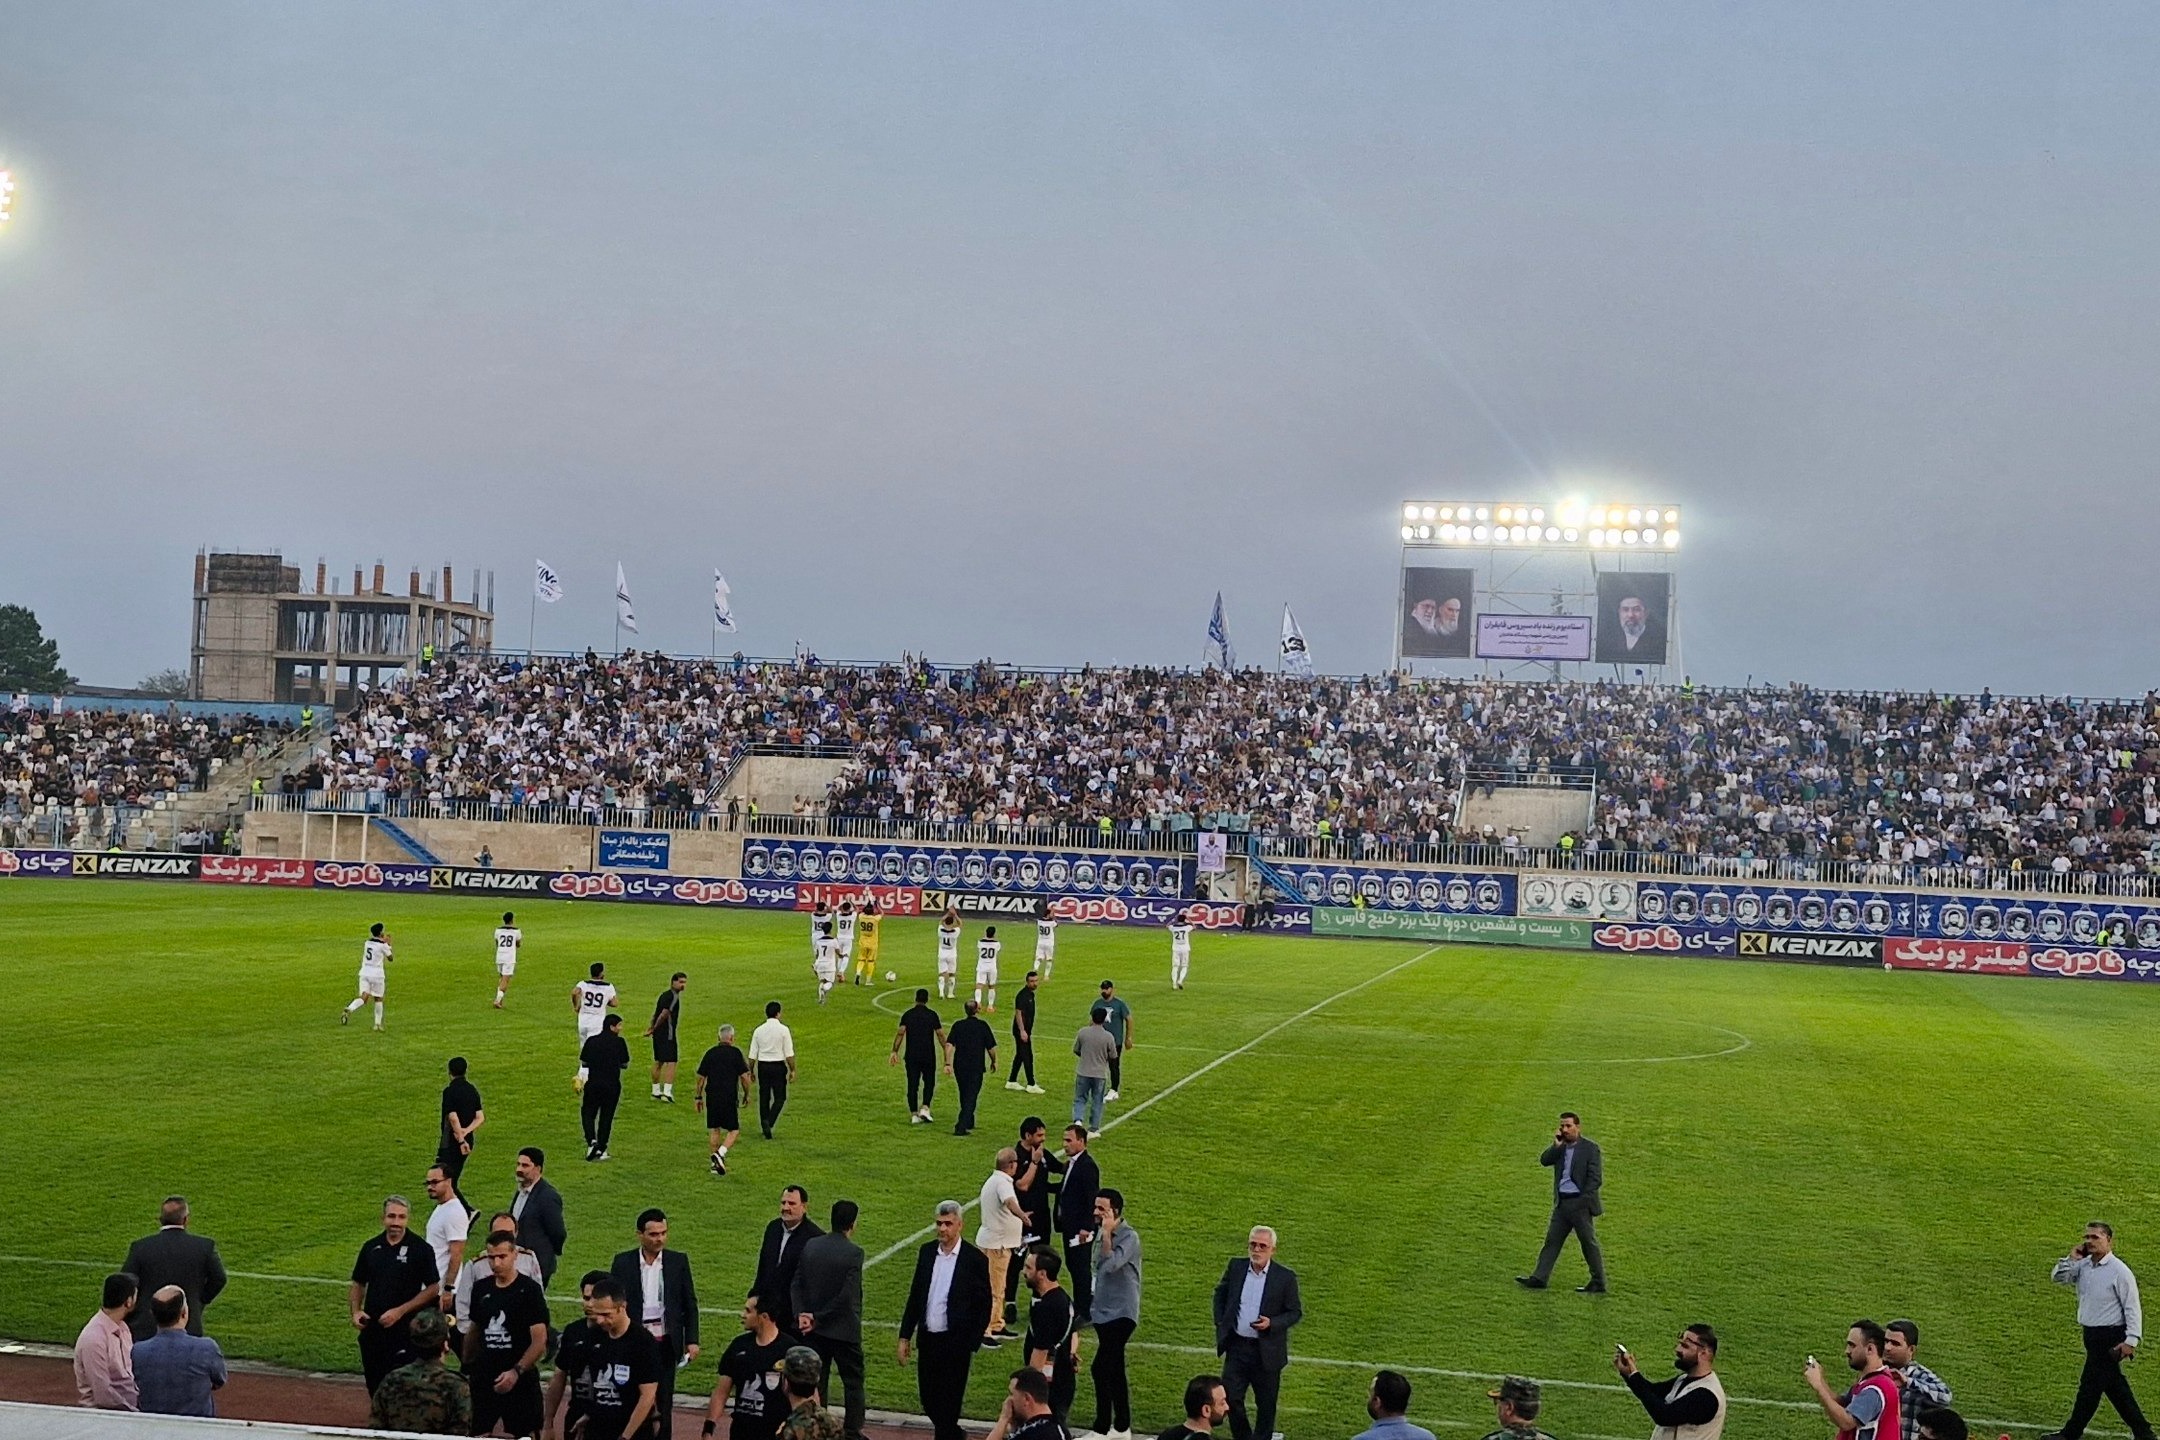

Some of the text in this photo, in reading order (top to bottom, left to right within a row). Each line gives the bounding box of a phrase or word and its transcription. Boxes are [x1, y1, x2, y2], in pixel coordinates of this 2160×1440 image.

[22, 853, 70, 873] چای
[100, 857, 192, 875] KENZAX
[314, 864, 429, 887] کلوچه نادری
[454, 872, 541, 890] KENZAX
[549, 873, 670, 898] چای نادری
[673, 879, 796, 904] کلوچه نادری
[879, 888, 915, 914] چای
[947, 893, 1038, 914] KENZAX
[1131, 902, 1176, 920] چای
[860, 921, 874, 933] 98
[1174, 930, 1186, 940] 27
[1529, 923, 1562, 937] بیست
[499, 934, 513, 948] 28
[942, 937, 951, 947] 4
[1594, 925, 1735, 952] چای نادری
[1769, 937, 1877, 958] KENZAX
[365, 947, 373, 961] 5
[821, 945, 828, 957] 7
[980, 947, 996, 960] 20
[2032, 949, 2125, 976] نادری
[583, 991, 604, 1008] 99
